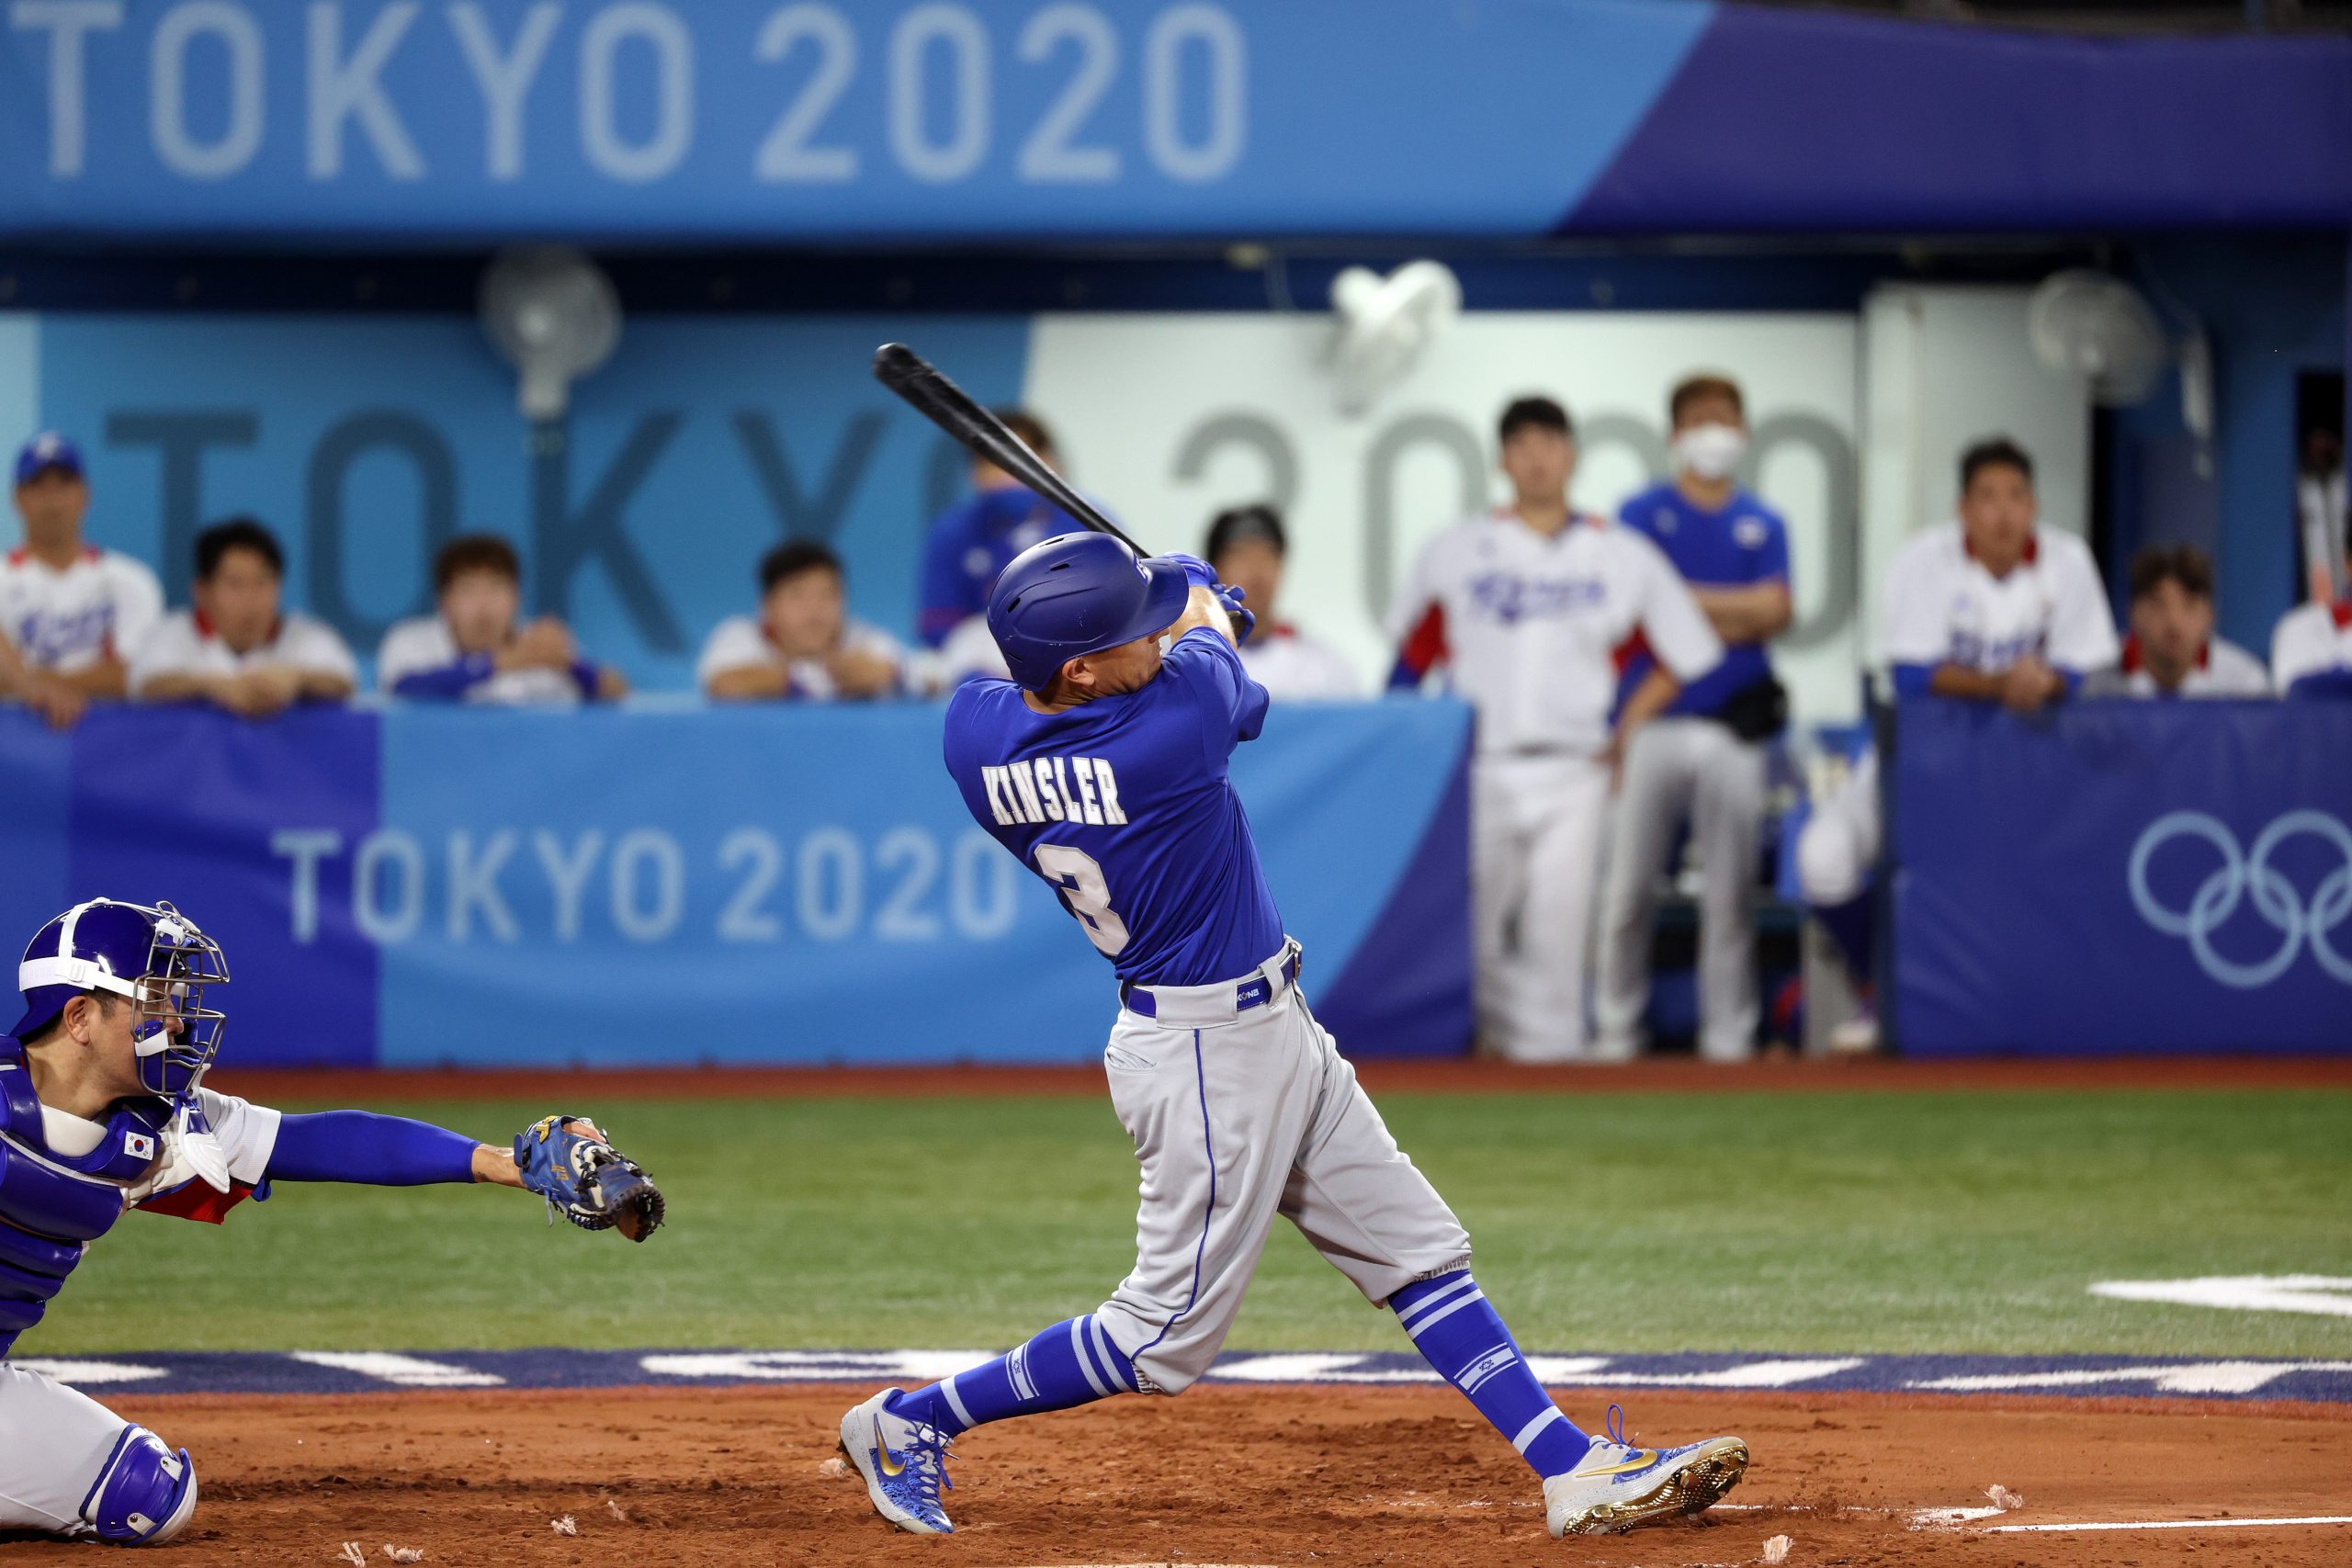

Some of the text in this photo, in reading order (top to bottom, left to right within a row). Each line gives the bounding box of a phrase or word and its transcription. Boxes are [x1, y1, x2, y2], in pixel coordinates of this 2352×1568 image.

[6, 0, 1251, 183] TOKYO 2020
[103, 408, 967, 655] TOKY
[980, 756, 1129, 826] KINSLER
[271, 827, 1020, 943] TOKYO 2020
[1034, 843, 1131, 957] 3
